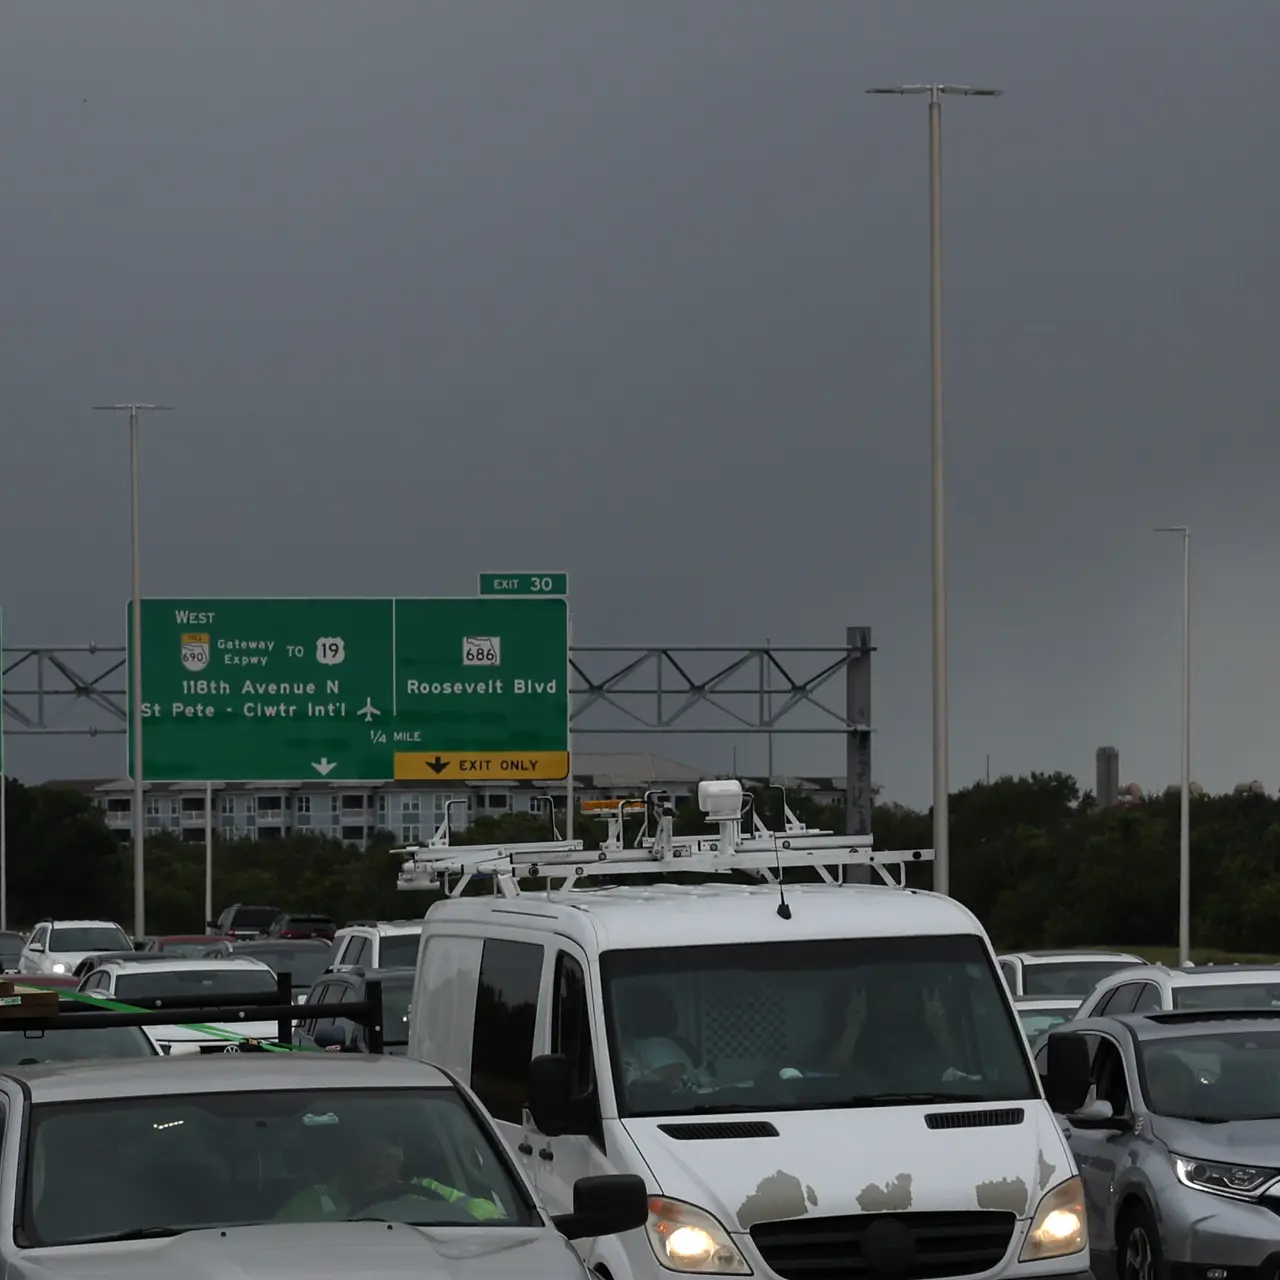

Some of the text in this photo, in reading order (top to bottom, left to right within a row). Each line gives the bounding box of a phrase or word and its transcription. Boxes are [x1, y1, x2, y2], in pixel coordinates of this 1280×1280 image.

[494, 577, 552, 591] EXIT 30
[218, 639, 275, 652] Gateway
[287, 646, 304, 657] TO
[322, 643, 338, 658] 19
[183, 652, 203, 663] 690
[225, 654, 268, 666] Expwy
[466, 648, 494, 662] 686
[182, 680, 339, 695] 118th Avenue N
[408, 680, 556, 694] Roosevelt Blvd
[140, 704, 161, 717] St
[173, 704, 215, 717] Pete
[244, 703, 297, 717] Clwtr
[308, 703, 345, 717] Int'l
[394, 732, 421, 741] MILE
[460, 760, 538, 771] EXIT ONLY
